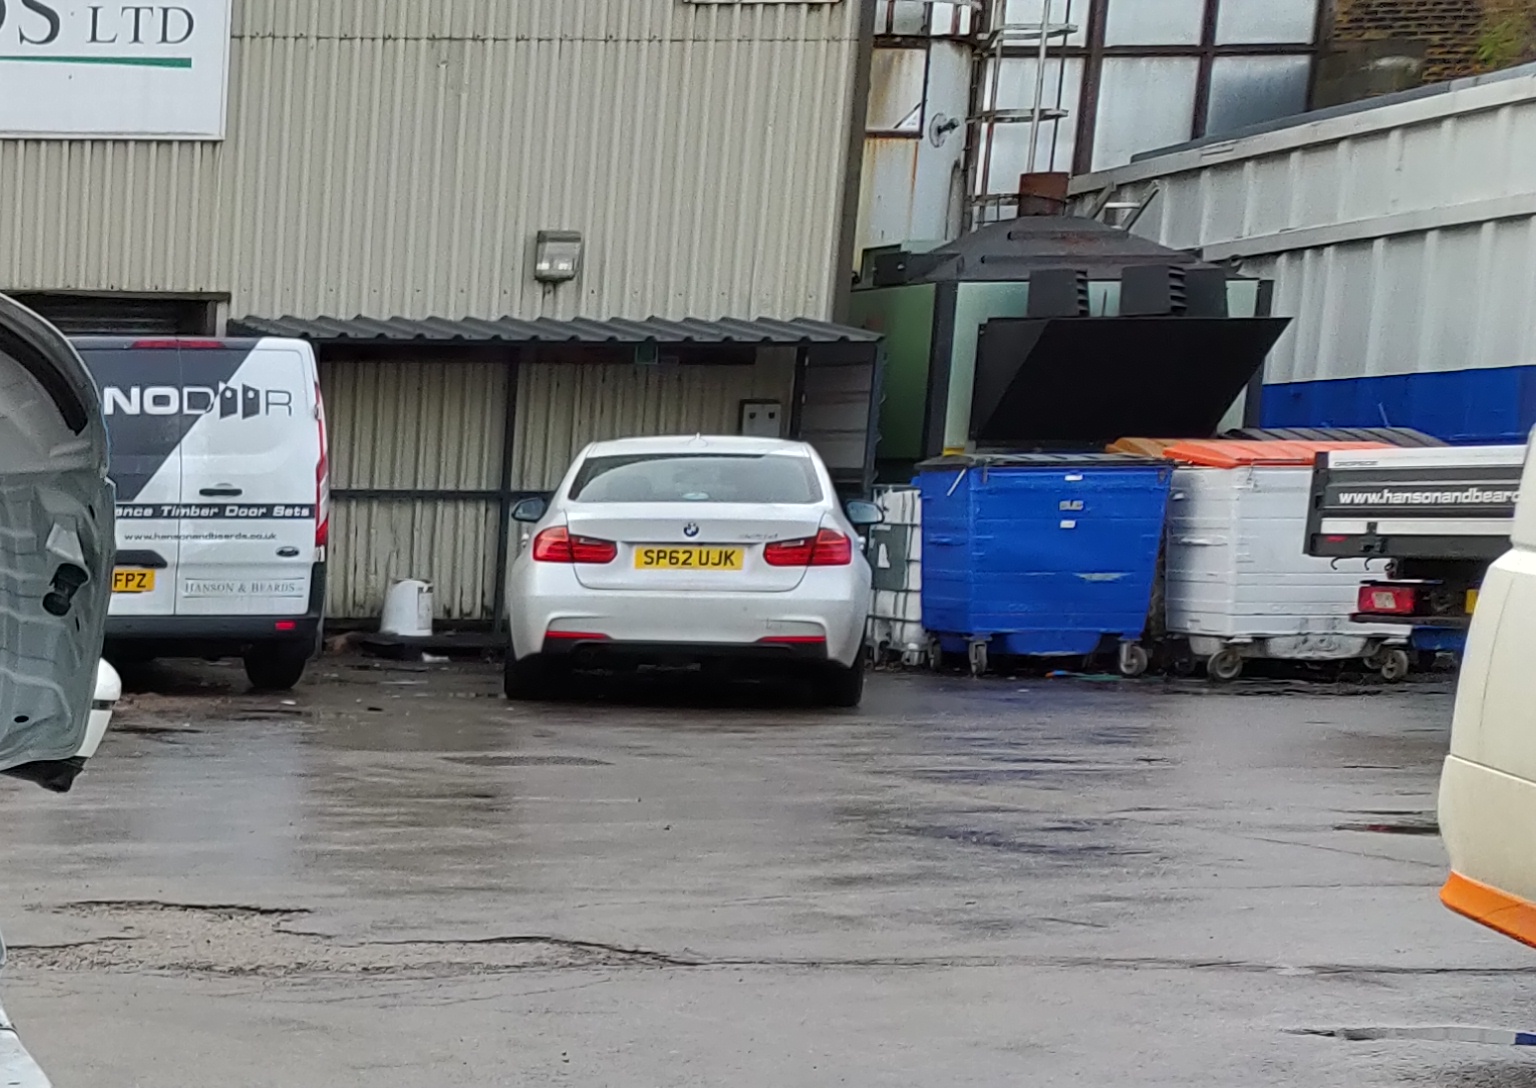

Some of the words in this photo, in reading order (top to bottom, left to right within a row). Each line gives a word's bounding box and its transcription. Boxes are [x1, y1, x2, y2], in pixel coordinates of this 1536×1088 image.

[85, 5, 195, 45] LTD
[160, 504, 219, 517] Timber
[224, 504, 267, 518] Door
[272, 504, 310, 518] Sets
[643, 549, 693, 567] SP62
[698, 549, 736, 567] UJK
[113, 572, 147, 589] FPZ
